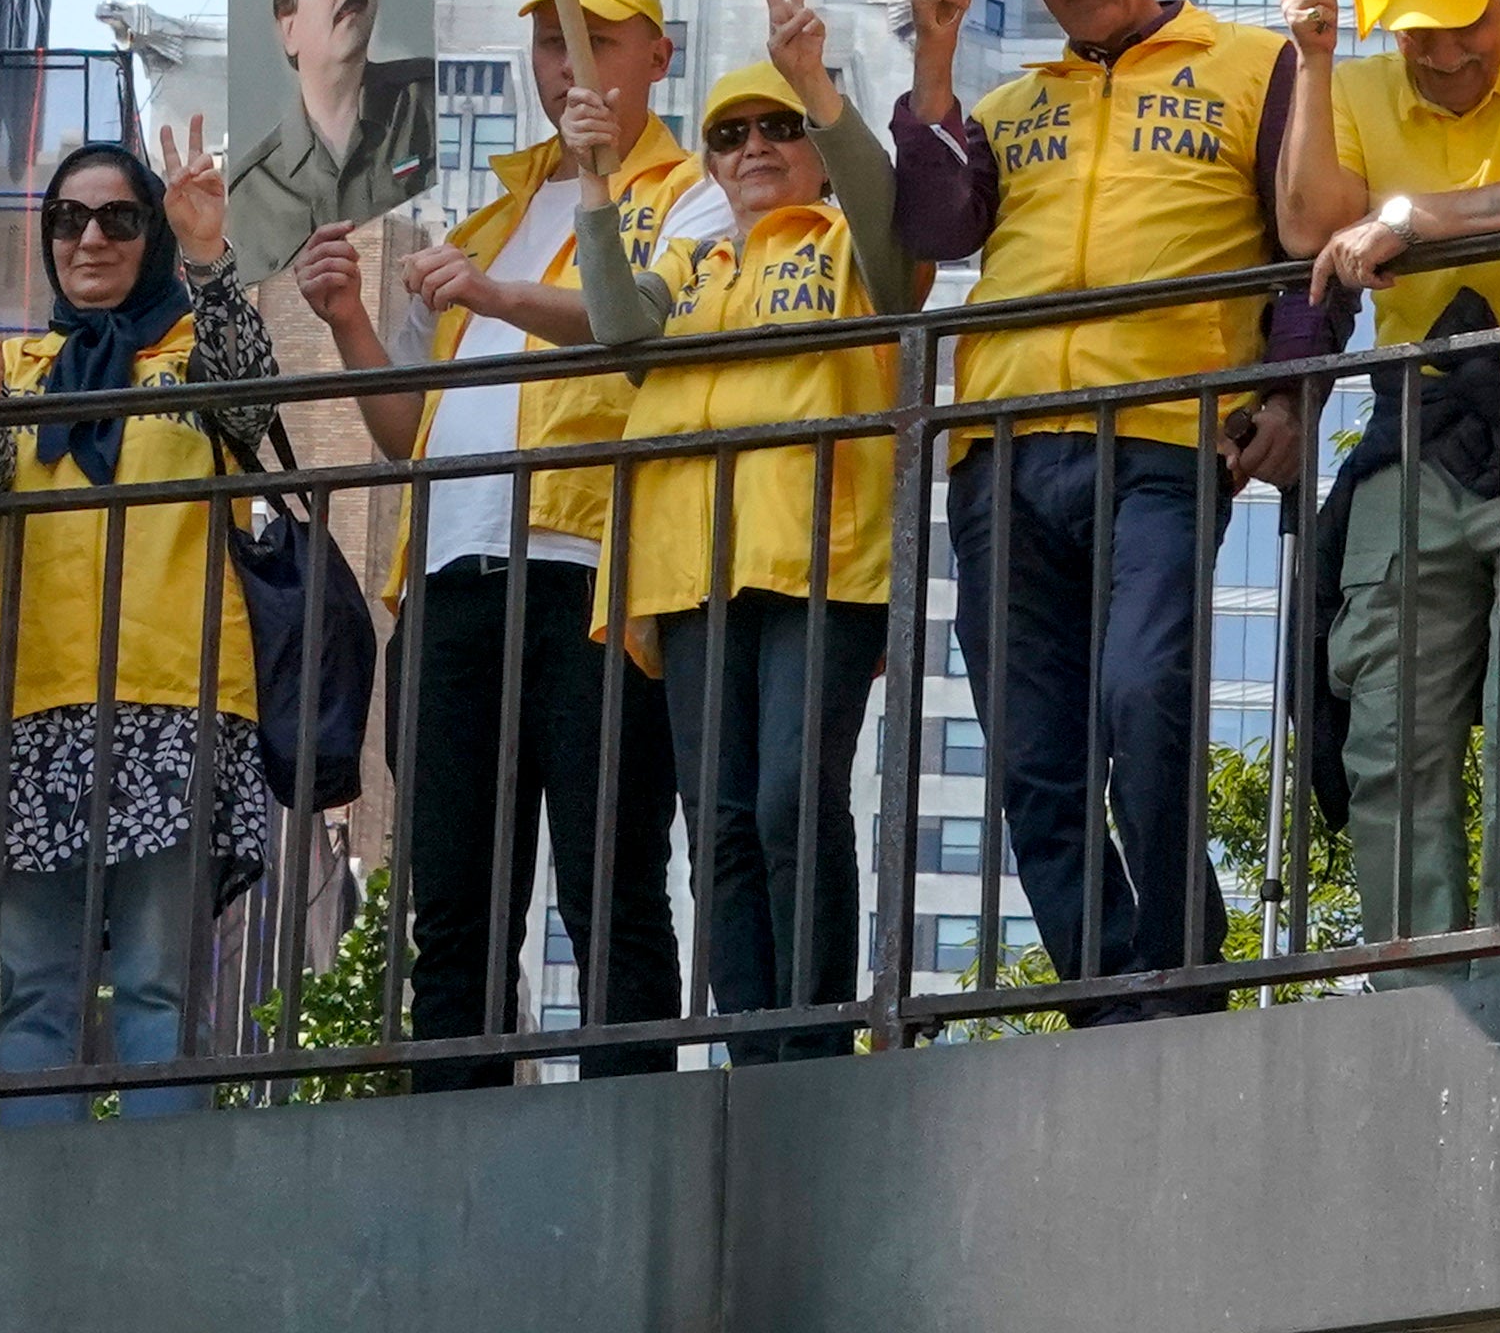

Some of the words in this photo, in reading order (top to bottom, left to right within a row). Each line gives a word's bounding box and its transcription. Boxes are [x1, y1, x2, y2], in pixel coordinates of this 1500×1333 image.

[1171, 65, 1196, 89] A
[1029, 86, 1048, 111] A
[1136, 94, 1226, 128] FREE
[992, 102, 1072, 141] FREE
[1132, 125, 1221, 164] IRAN
[795, 242, 816, 262] A
[762, 253, 835, 283] FREE
